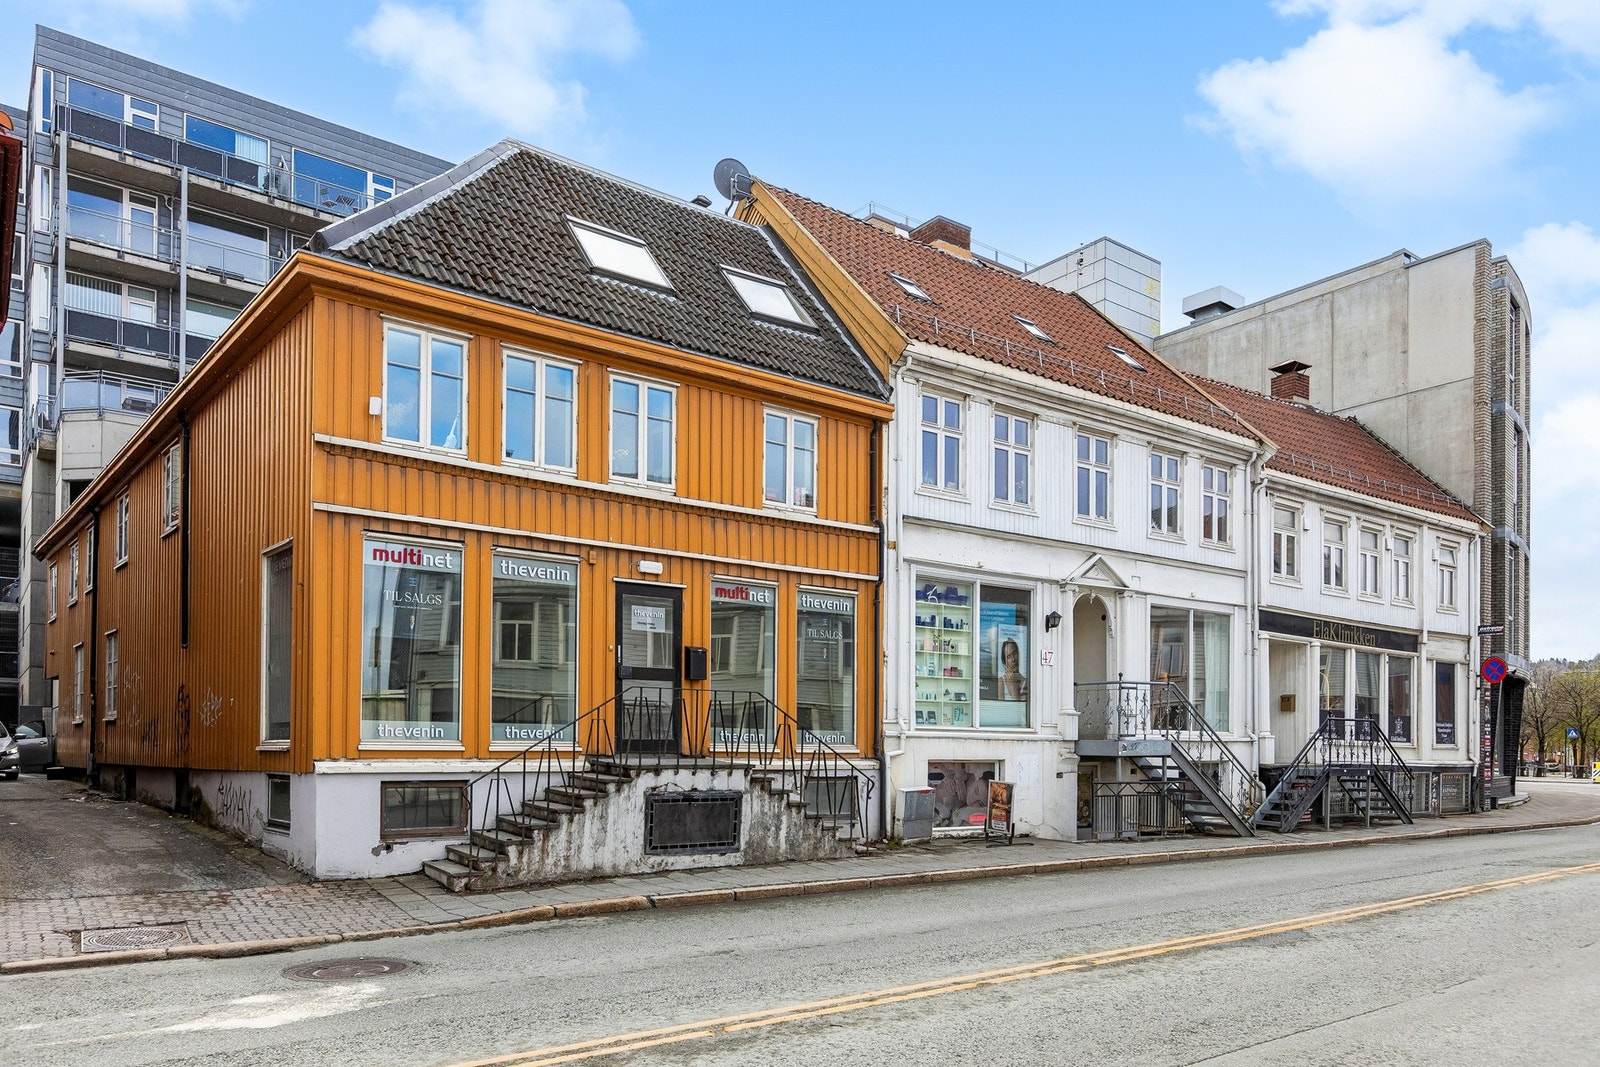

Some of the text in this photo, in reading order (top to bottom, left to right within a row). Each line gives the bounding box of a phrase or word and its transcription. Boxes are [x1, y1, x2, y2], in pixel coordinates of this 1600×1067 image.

[372, 547, 453, 569] multinet
[500, 559, 570, 582] thevenin
[383, 590, 442, 605] TIL SALGS
[714, 586, 770, 603] multinet
[801, 594, 850, 612] thevenin
[633, 608, 664, 619] thevenin
[807, 628, 843, 640] TIL SALGS
[1312, 620, 1376, 647] ElaKlinikken
[1042, 651, 1054, 664] 47
[377, 723, 444, 739] thevenin
[505, 726, 564, 739] thevenin
